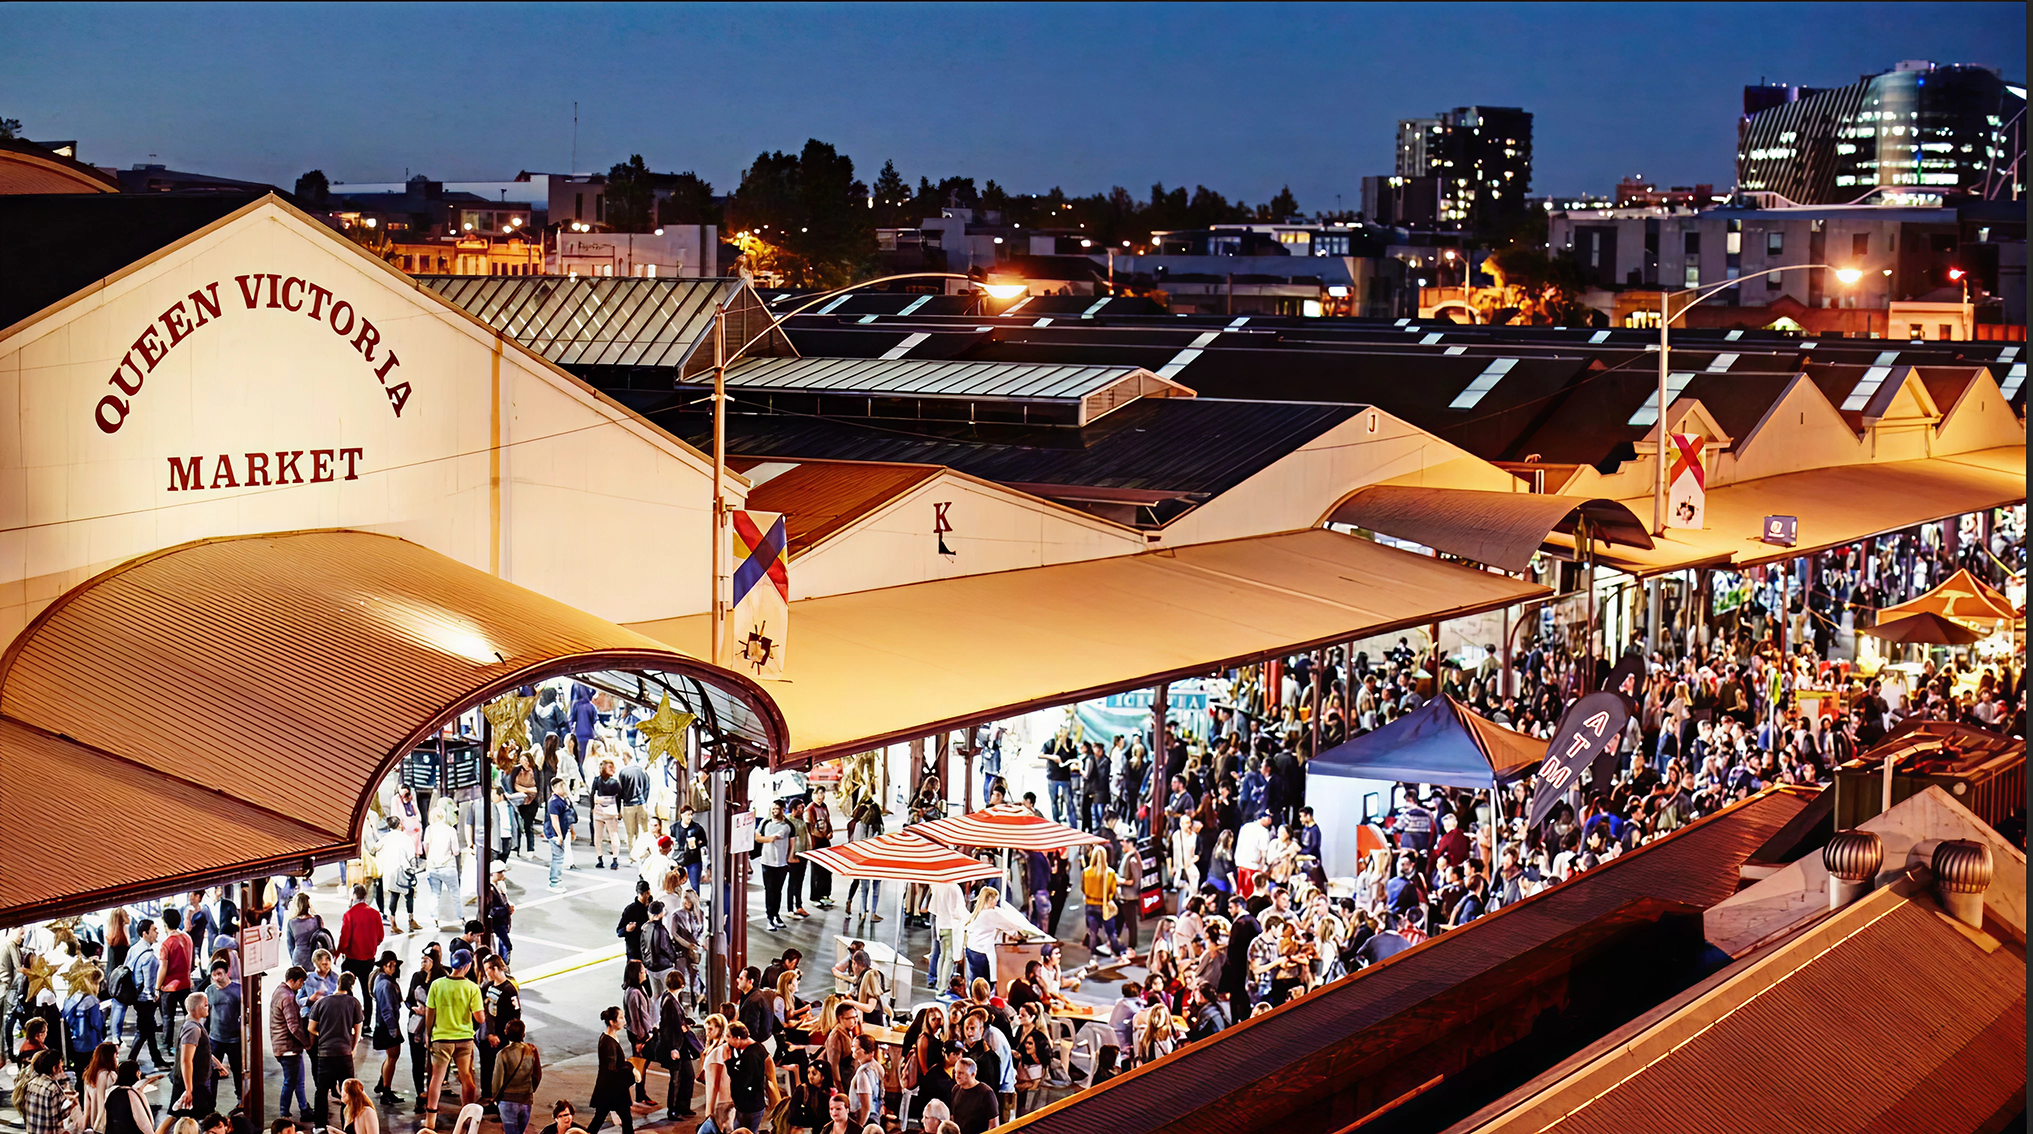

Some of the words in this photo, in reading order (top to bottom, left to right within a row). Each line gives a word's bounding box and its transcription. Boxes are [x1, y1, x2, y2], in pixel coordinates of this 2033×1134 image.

[95, 281, 222, 434] QUEEN
[234, 273, 413, 418] VICTORIA
[166, 447, 363, 492] MARKET
[1537, 710, 1611, 790] ATM
